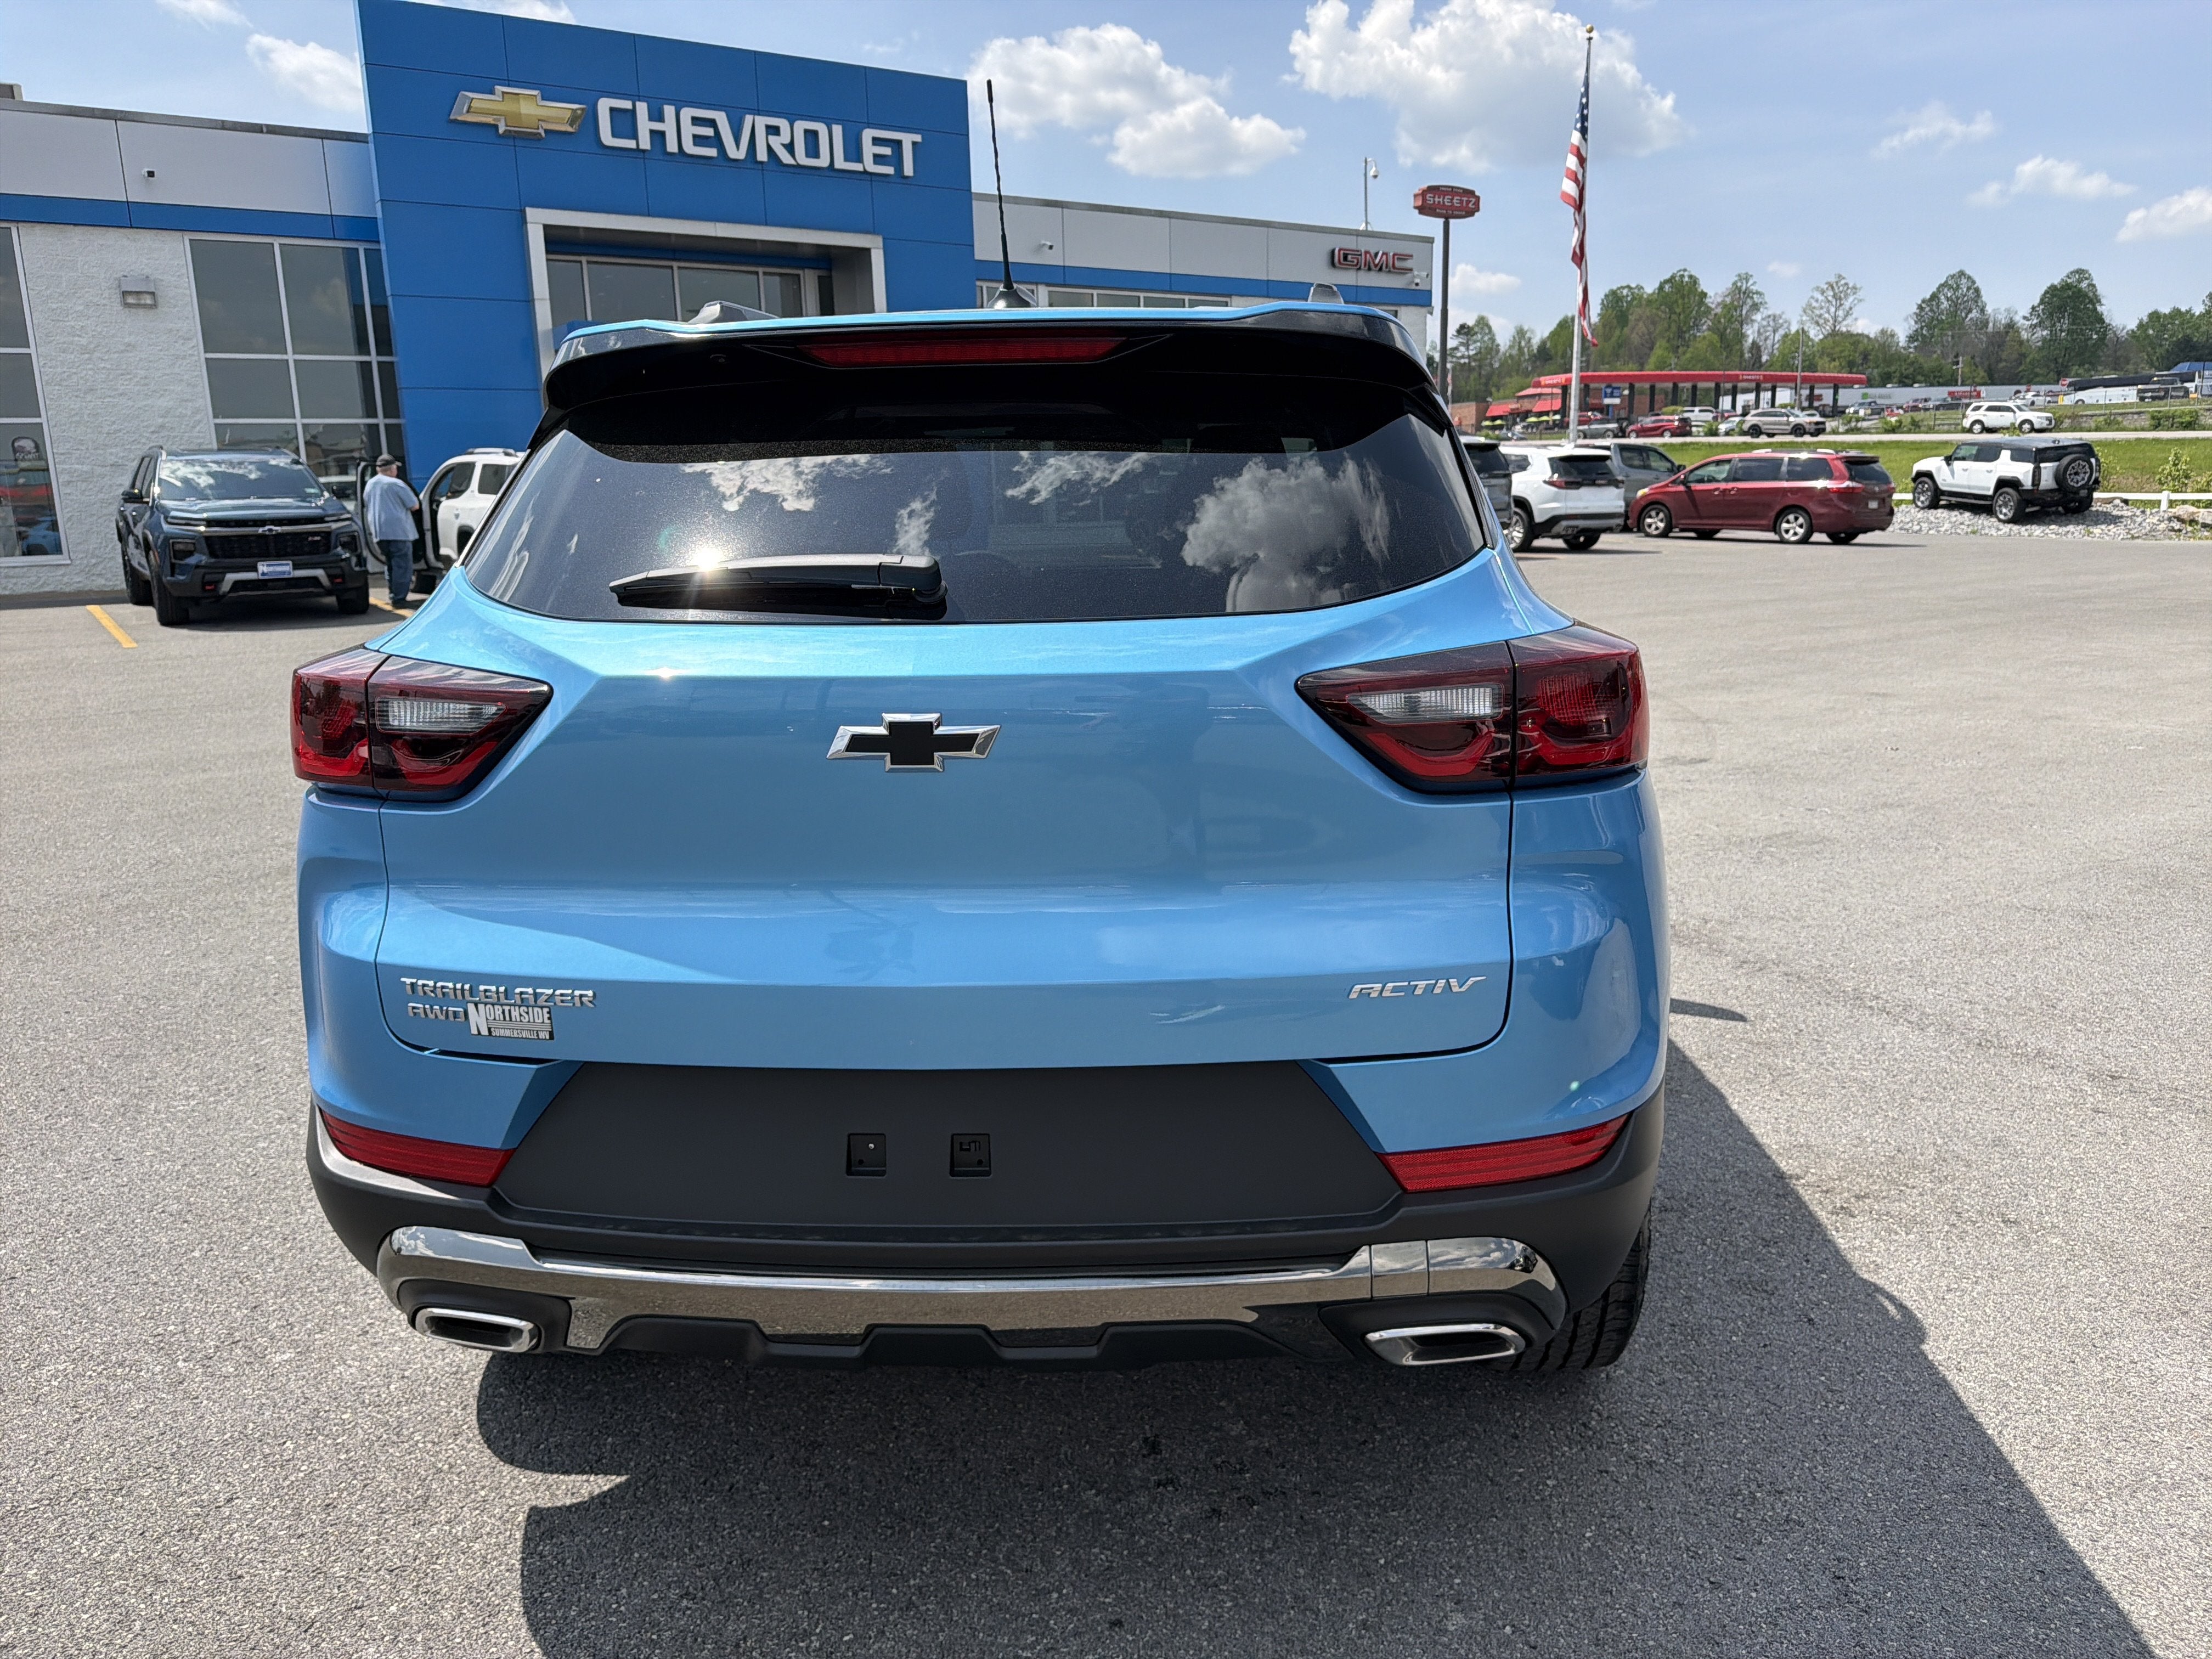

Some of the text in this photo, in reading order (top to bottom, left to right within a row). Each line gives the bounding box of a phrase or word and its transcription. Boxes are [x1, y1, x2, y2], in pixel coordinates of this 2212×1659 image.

[597, 97, 922, 177] CHEVROLET
[1426, 193, 1476, 208] SHEETZ
[1334, 247, 1414, 272] GMC
[400, 977, 596, 1008] TRAILBLAZER
[1348, 976, 1487, 999] ACTIV
[407, 1002, 467, 1022] AWD
[467, 1002, 551, 1036] NORTHSIDE
[490, 1027, 550, 1040] SUMMERSVILLE WV
